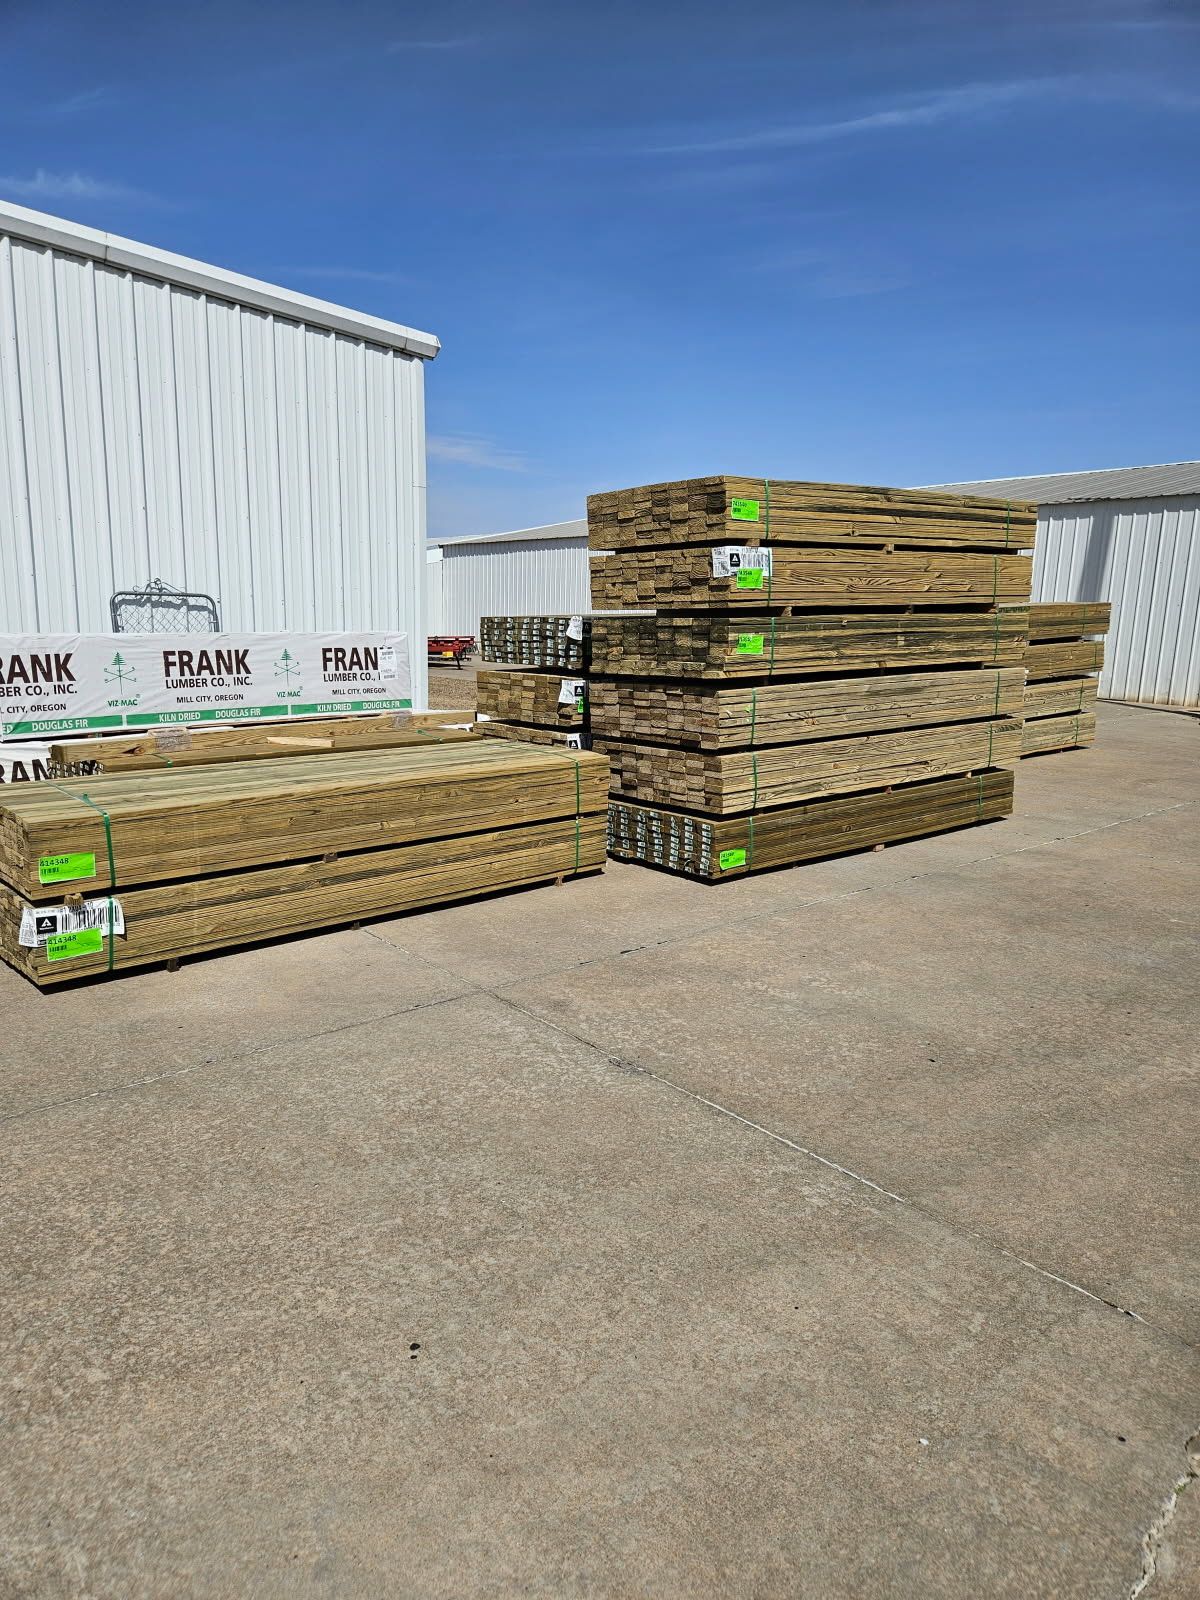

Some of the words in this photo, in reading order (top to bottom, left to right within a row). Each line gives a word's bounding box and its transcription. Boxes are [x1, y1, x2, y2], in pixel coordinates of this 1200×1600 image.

[162, 649, 252, 677] FRANK
[321, 647, 380, 672] FRAN
[165, 678, 208, 689] LUMBER
[211, 677, 230, 687] CO.,
[233, 676, 253, 686] INC.
[323, 672, 358, 682] LUMBER
[25, 685, 49, 696] CO.,
[53, 683, 78, 694] INC.
[107, 699, 138, 707] VIZ-MAC
[176, 696, 194, 704] MILL
[317, 704, 332, 712] KILN
[332, 703, 352, 711] DRIED
[362, 701, 390, 709] DOUGLAS
[391, 700, 401, 708] FIR
[6, 705, 28, 714] CITY,
[30, 703, 67, 712] OREGON
[158, 713, 177, 722] KILN
[178, 711, 201, 721] DRIED
[215, 709, 249, 718] DOUGLAS
[250, 708, 261, 716] FIR
[32, 720, 73, 732] DOUGLAS
[75, 718, 89, 728] FIR
[39, 857, 70, 867] 414348
[48, 934, 77, 945] 414348
